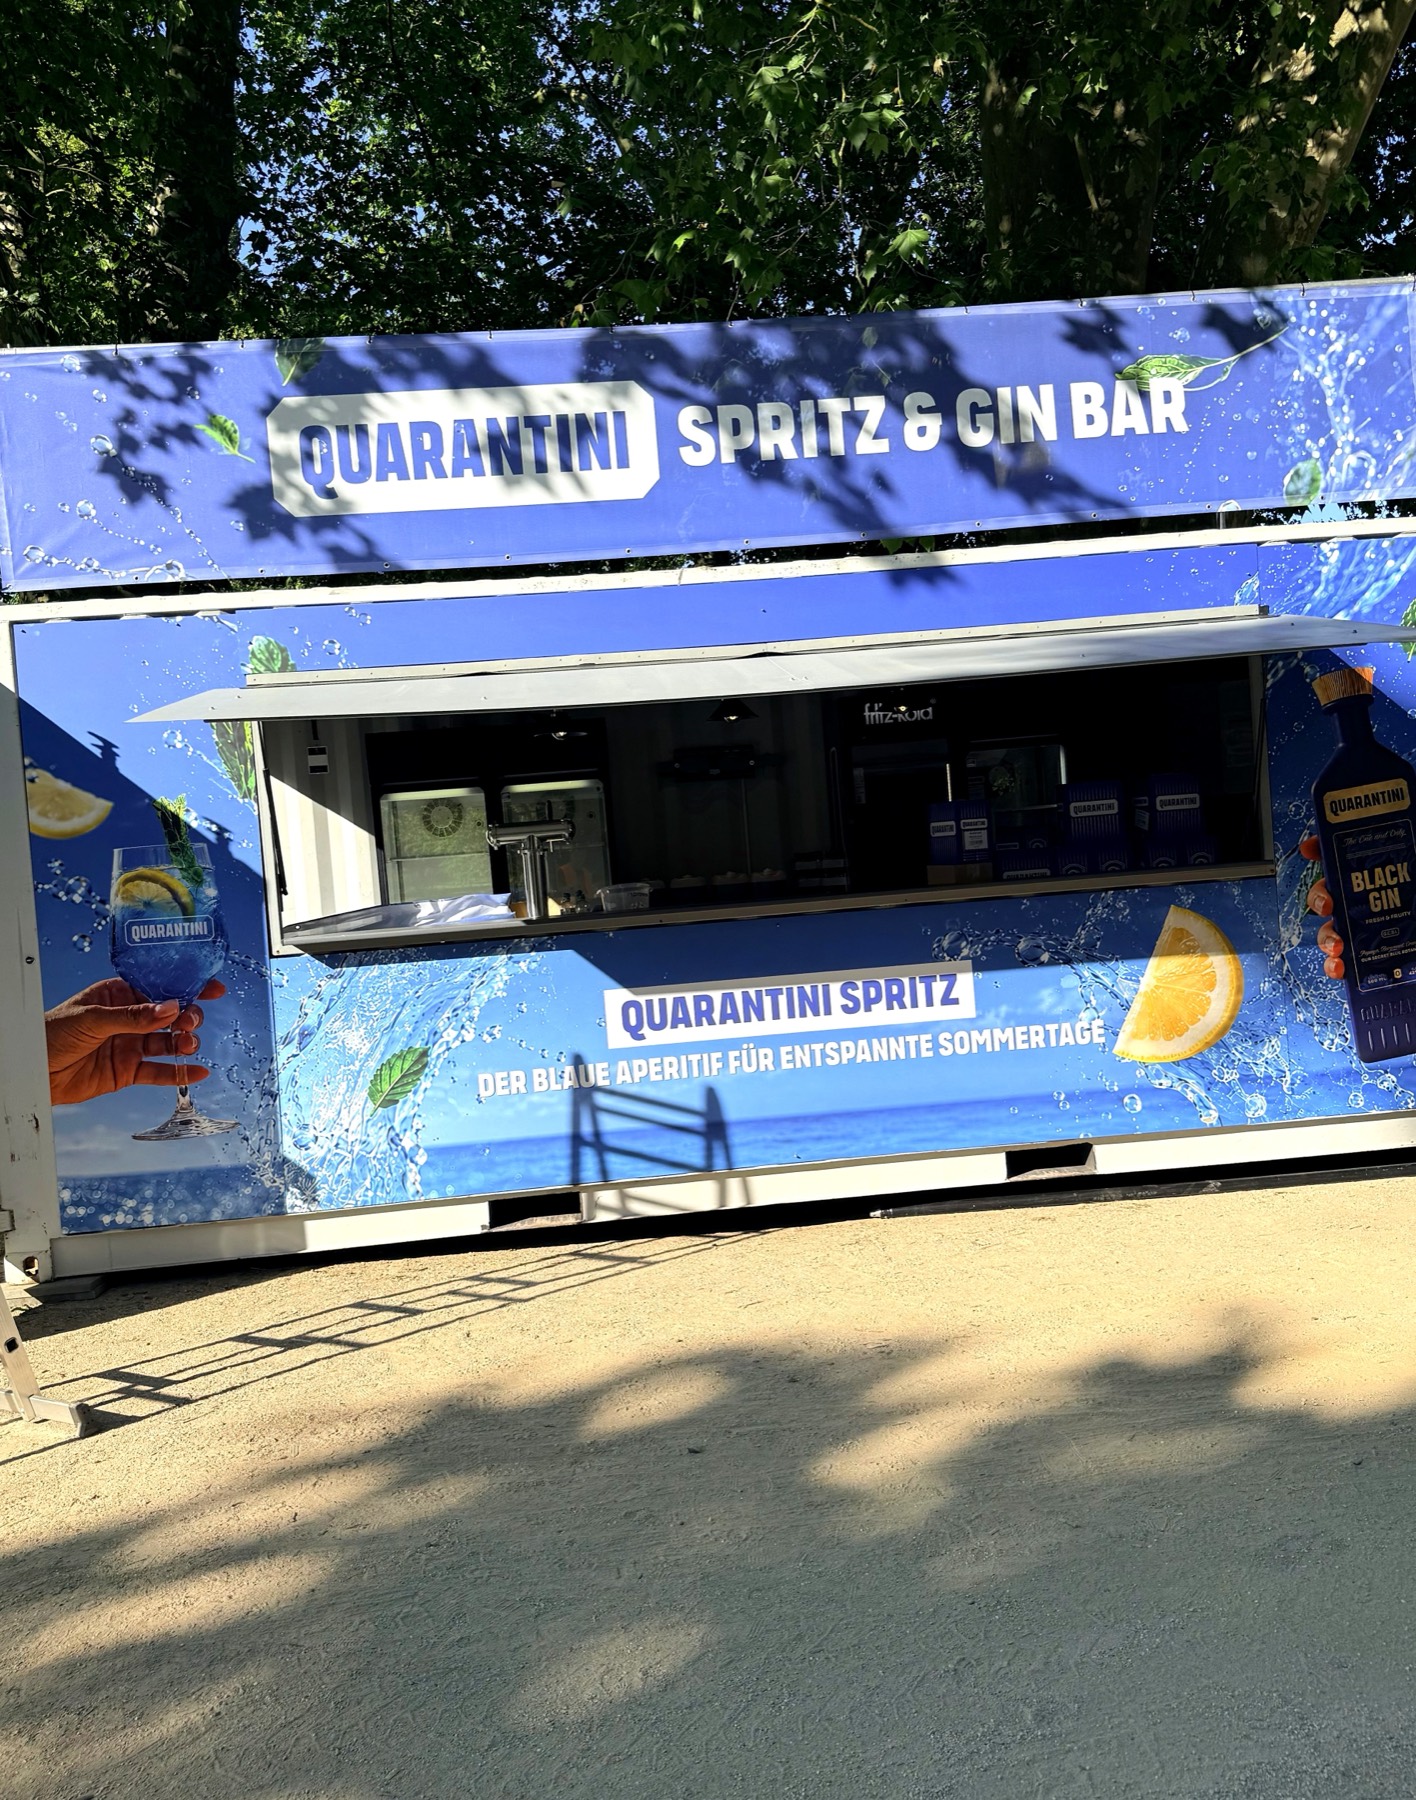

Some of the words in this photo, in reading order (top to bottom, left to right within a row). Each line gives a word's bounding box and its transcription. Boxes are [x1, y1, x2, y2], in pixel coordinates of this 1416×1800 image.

[299, 411, 630, 499] QUARANTINI
[678, 396, 890, 467] SPRITZ
[904, 390, 943, 451] &
[956, 384, 1059, 448] GIN
[1069, 377, 1190, 442] BAR
[1329, 787, 1404, 816] QUARANTINI
[1351, 862, 1411, 892] BLACK
[1368, 888, 1401, 913] GIN
[131, 922, 208, 942] QUARANTINI
[621, 986, 831, 1041] QUARANTINI
[840, 973, 960, 1014] SPRITZ
[477, 1069, 527, 1098] DER
[532, 1061, 611, 1093] BLAUE
[615, 1054, 724, 1085] APERITIF
[729, 1042, 776, 1074] FÜR
[780, 1035, 934, 1069] ENTSPANNTE
[938, 1021, 1105, 1056] SOMMERTAGE
